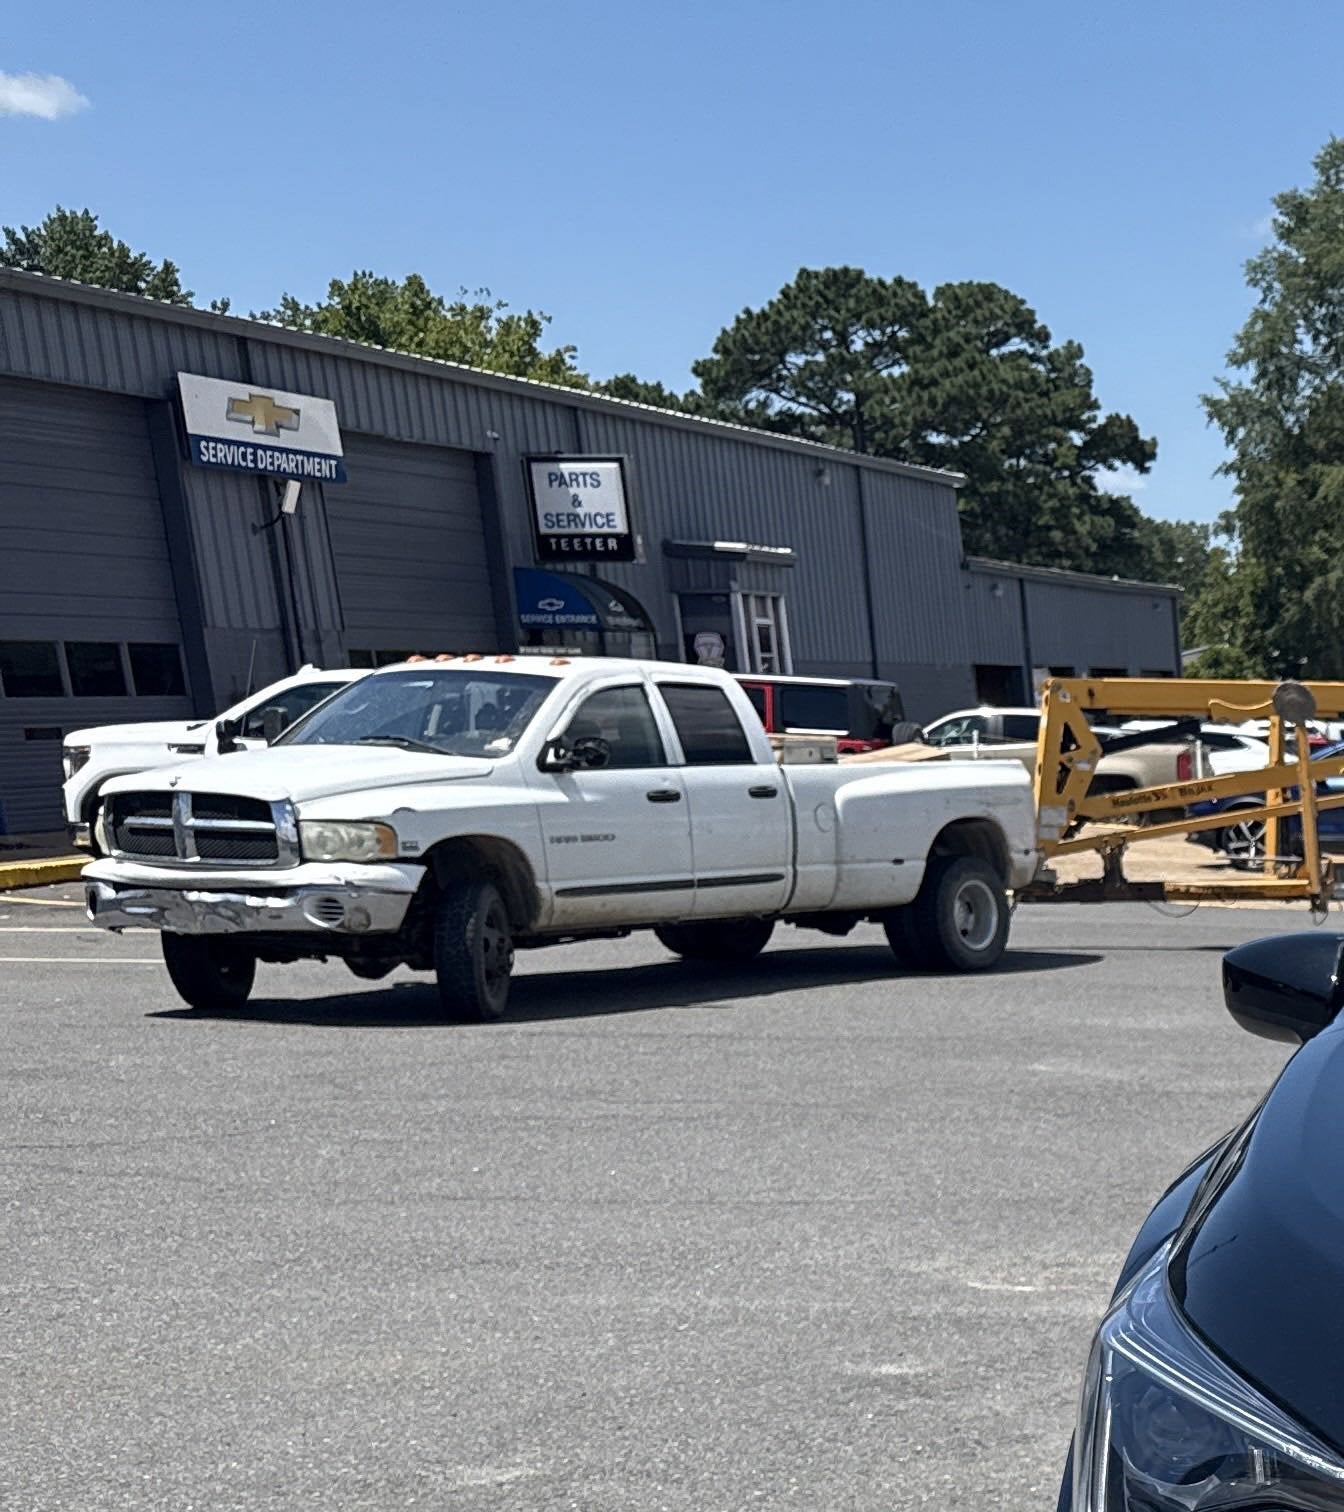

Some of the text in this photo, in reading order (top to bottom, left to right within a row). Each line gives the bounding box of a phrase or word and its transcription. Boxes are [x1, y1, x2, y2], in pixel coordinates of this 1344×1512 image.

[200, 440, 337, 479] SERVICE DEPARTMENT
[548, 472, 602, 489] PARTS
[571, 493, 583, 508] &
[543, 512, 617, 529] SERVICE
[549, 537, 618, 551] TEETER
